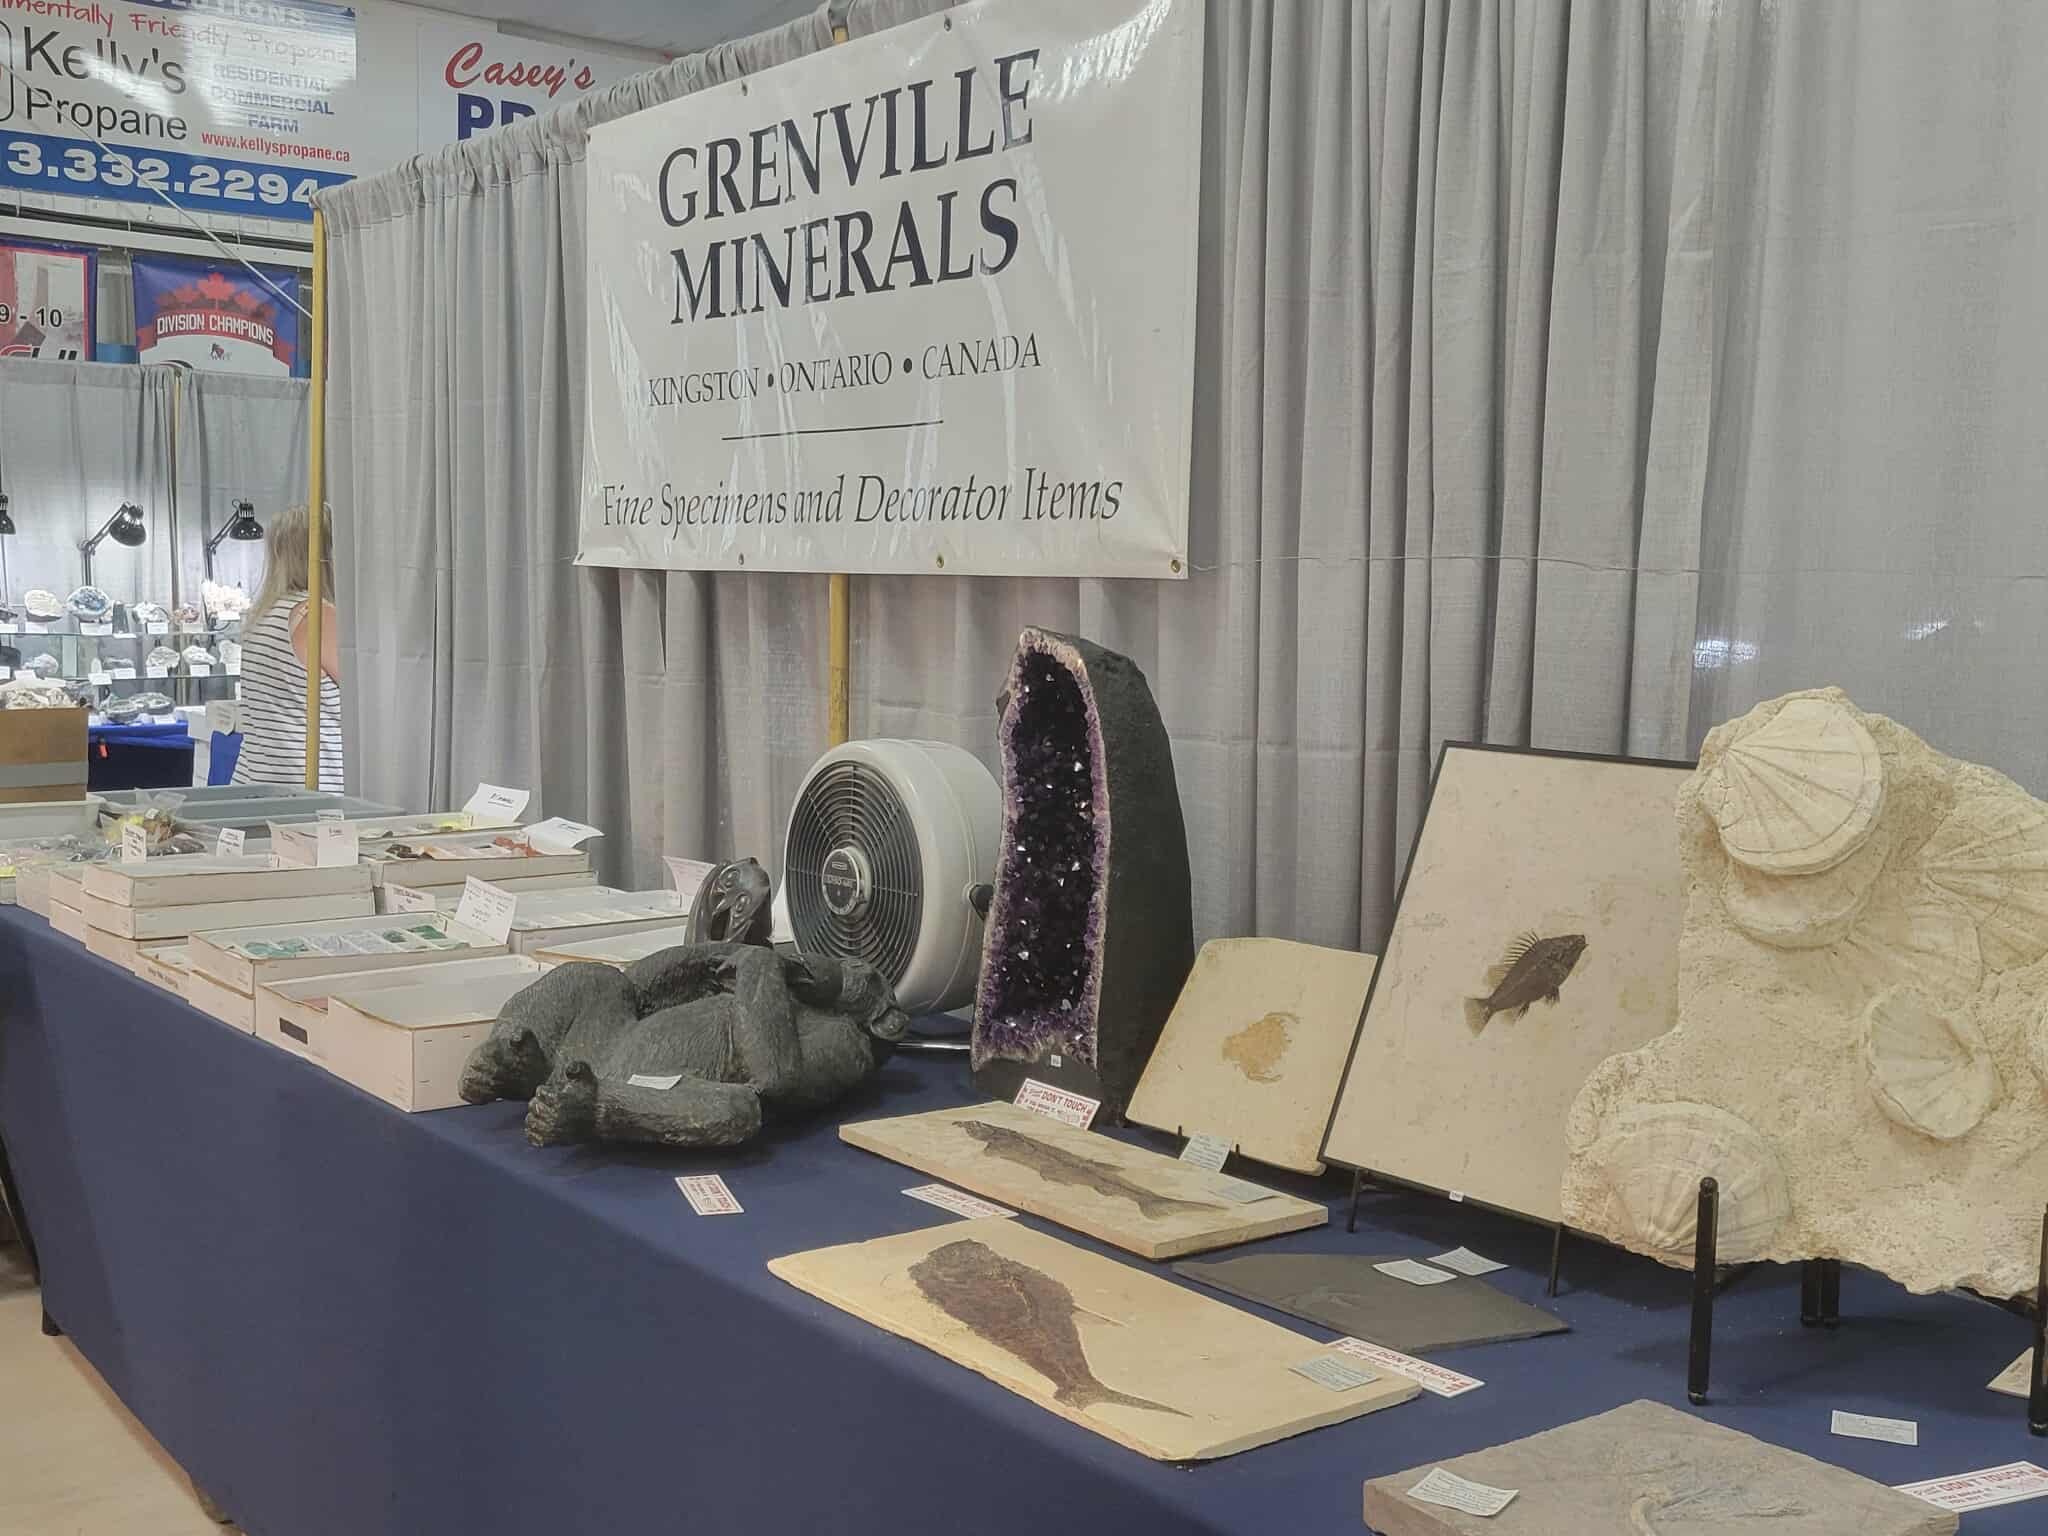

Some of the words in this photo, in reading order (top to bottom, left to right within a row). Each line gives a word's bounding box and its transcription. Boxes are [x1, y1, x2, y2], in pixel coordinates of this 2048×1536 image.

[24, 26, 186, 98] Kelly's
[128, 13, 229, 56] Friendly
[244, 28, 348, 65] Propane
[213, 64, 332, 92] RESIDENTIAL
[444, 42, 596, 98] Casey's
[27, 86, 187, 140] Propane
[211, 85, 335, 115] COMMERCIAL
[248, 113, 299, 133] FARM
[201, 132, 350, 162] www.kellyspropane.ca
[658, 48, 1041, 227] GRENVILLE
[7, 141, 320, 205] 3.332.2294
[670, 178, 1020, 324] MINERALS
[36, 307, 62, 327] 10
[157, 313, 205, 335] DIVISION
[209, 314, 274, 346] CHAMPIONS
[648, 367, 760, 407] KINGSTON
[780, 350, 893, 393] ONTARIO
[921, 333, 1042, 380] CANADA
[602, 484, 653, 526] Fine
[660, 481, 787, 540] Specimens
[793, 473, 846, 524] and
[854, 473, 1013, 525] Decorator
[1021, 467, 1124, 521] Items
